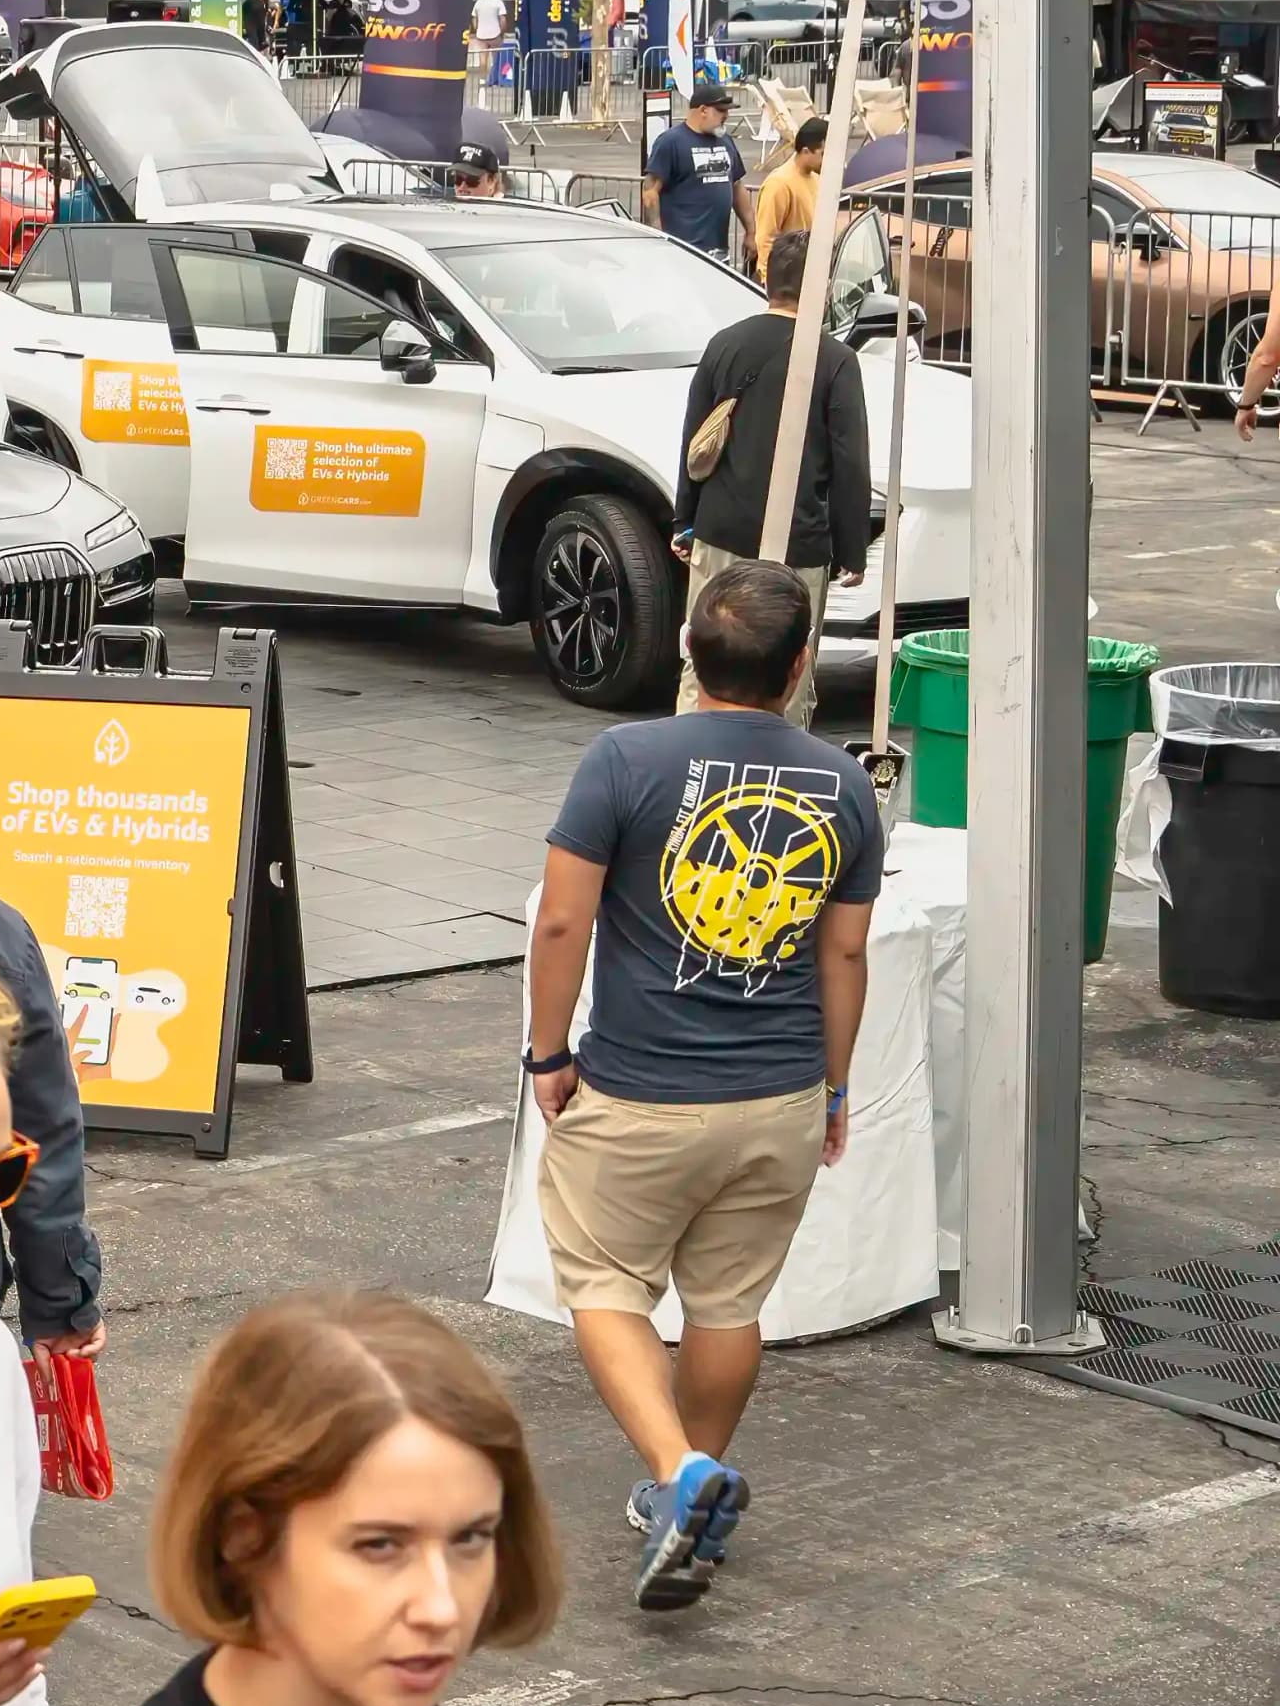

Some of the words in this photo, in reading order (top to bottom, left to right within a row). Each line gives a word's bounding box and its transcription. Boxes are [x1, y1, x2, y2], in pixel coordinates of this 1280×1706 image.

[138, 388, 182, 398] selectio
[314, 440, 343, 455] Shop
[344, 441, 364, 454] the
[365, 442, 413, 457] ultimate
[313, 455, 364, 468] selection
[365, 456, 380, 467] of
[312, 468, 333, 480] EVs
[333, 468, 346, 480] &
[346, 469, 391, 483] Hybrids
[688, 758, 705, 780] FAT.
[7, 780, 70, 812] Shop
[76, 784, 210, 814] thousands
[681, 779, 701, 810] KINDA
[1, 809, 32, 834] of
[33, 810, 80, 836] EVs
[84, 814, 108, 837] &
[112, 815, 211, 845] Hybrids
[13, 850, 53, 864] Search
[55, 854, 64, 865] a
[65, 853, 132, 870] nationwide
[134, 858, 191, 876] inventory
